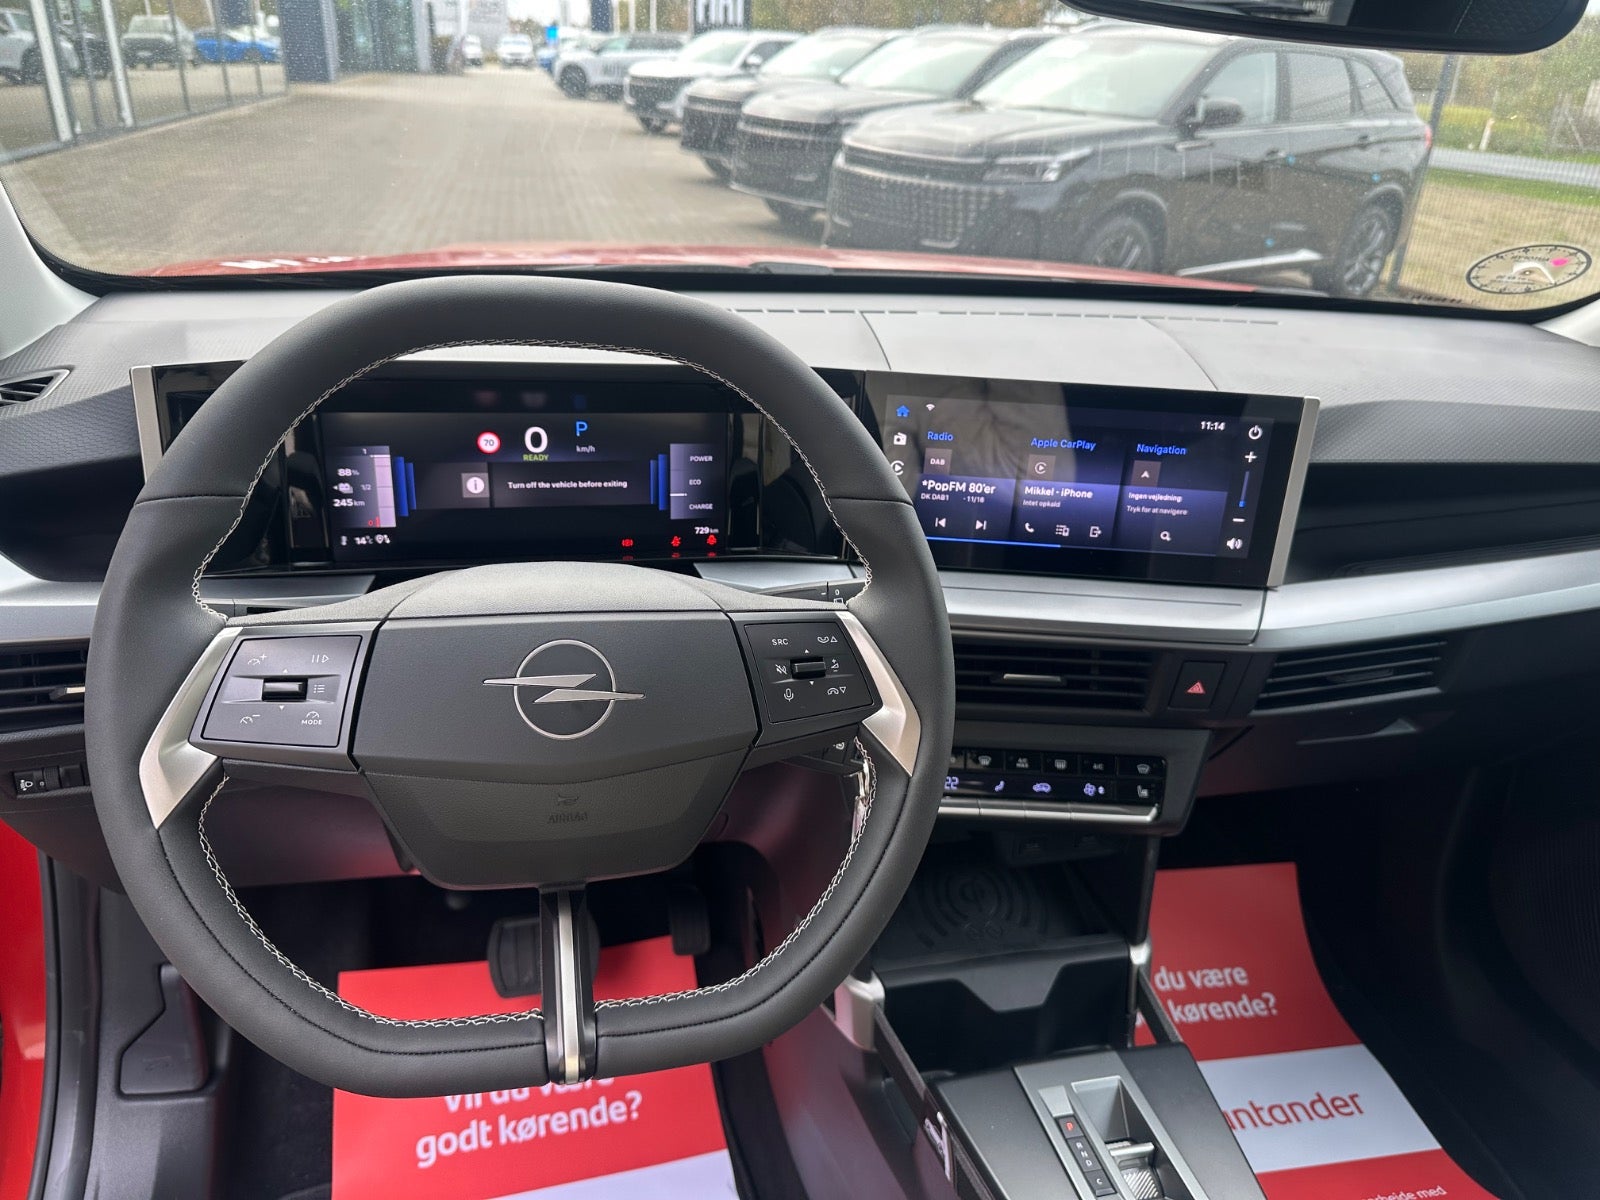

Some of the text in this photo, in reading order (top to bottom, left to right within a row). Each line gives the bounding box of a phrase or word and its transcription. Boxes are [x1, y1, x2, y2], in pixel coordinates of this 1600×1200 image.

[576, 421, 588, 436] P
[1200, 421, 1226, 431] 11:14
[524, 426, 548, 453] 0
[927, 431, 954, 441] Radio
[483, 439, 495, 447] 70
[1031, 438, 1097, 451] Apple CarPlay
[575, 445, 596, 453] km/h
[1136, 443, 1187, 456] Navigation
[523, 454, 549, 462] READY
[930, 458, 945, 466] DAB
[527, 481, 537, 489] off
[538, 481, 550, 489] the
[551, 481, 577, 489] vehicle
[578, 481, 602, 489] before
[603, 480, 628, 489] exiting
[1024, 485, 1055, 497] Mikkel
[1060, 487, 1094, 499] iPhone
[1128, 491, 1148, 501] Ingen
[1022, 499, 1038, 507] Intet
[1159, 507, 1188, 516] navigere
[772, 638, 789, 646] SRC
[944, 776, 959, 790] 22
[1154, 966, 1248, 991] du være
[1167, 992, 1278, 1024] kørende?
[1222, 1092, 1365, 1131] ntander
[415, 1090, 643, 1168] godt kørende?
[1066, 1122, 1074, 1131] P
[1416, 1185, 1448, 1198] med
